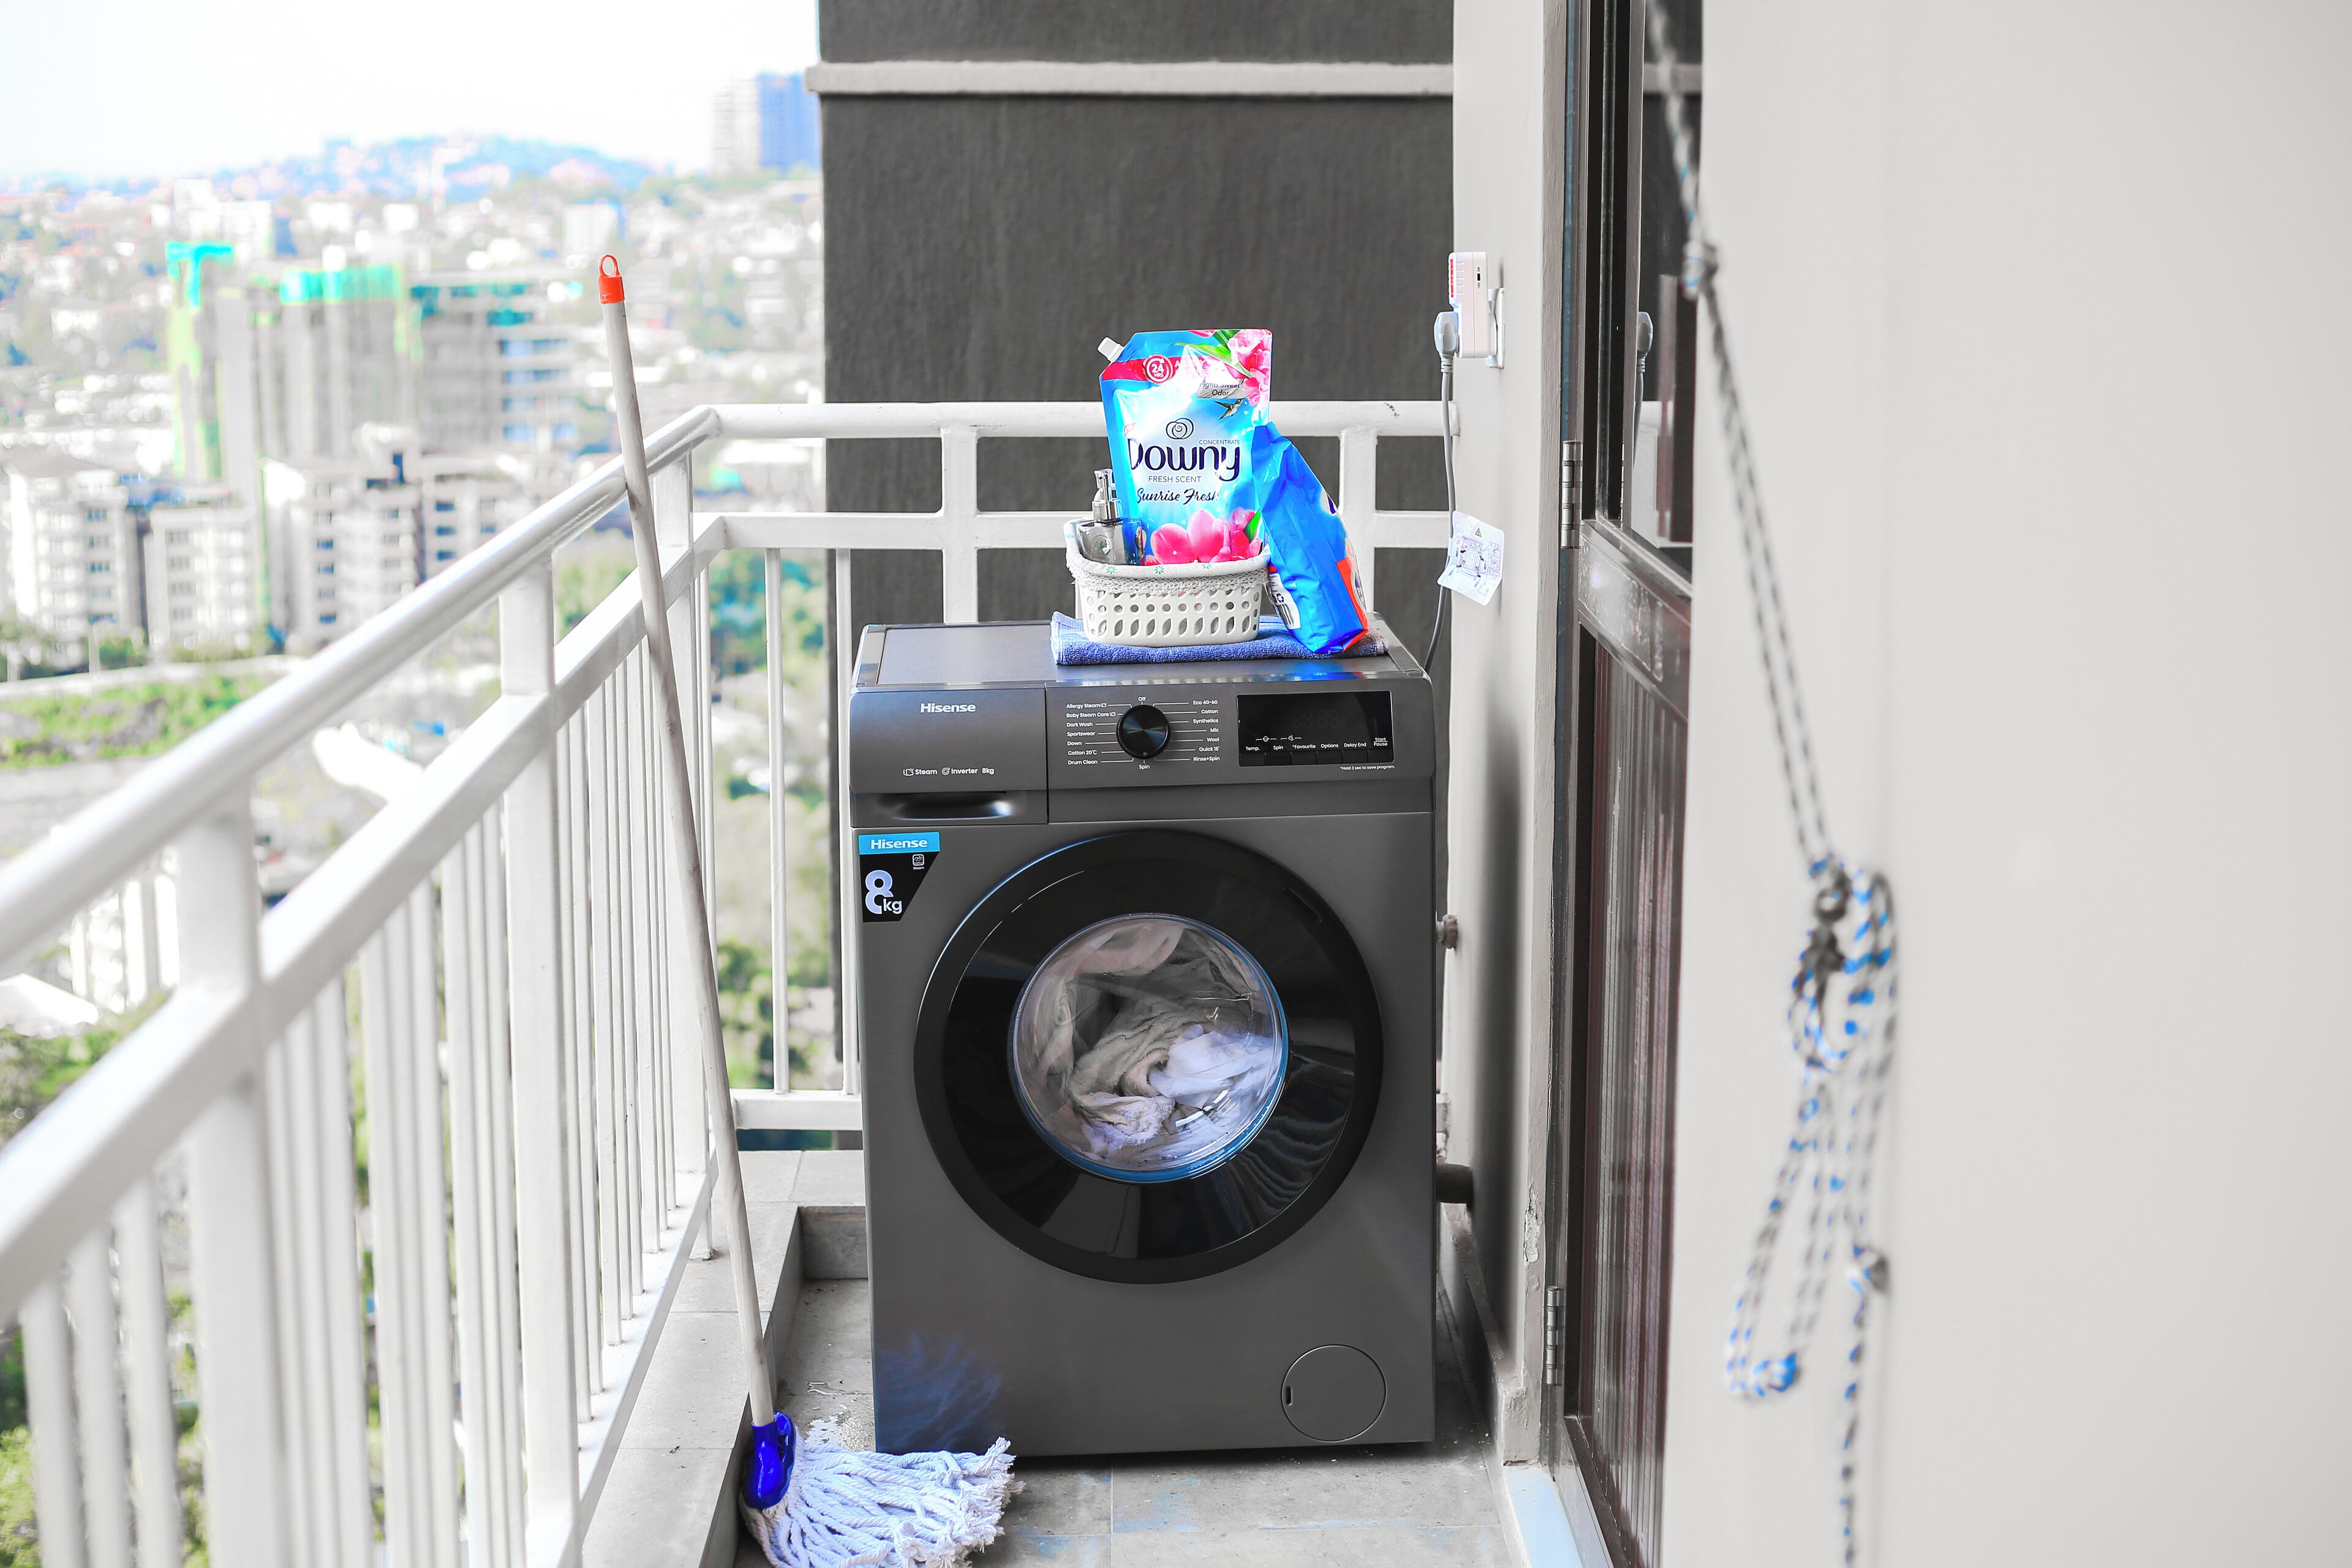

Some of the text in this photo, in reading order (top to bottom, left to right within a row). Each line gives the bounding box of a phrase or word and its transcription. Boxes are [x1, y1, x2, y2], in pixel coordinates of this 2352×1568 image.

[1152, 364, 1164, 372] 24
[1128, 438, 1240, 481] Downy
[1137, 488, 1181, 503] Sunrise
[920, 703, 976, 713] Hisense
[871, 839, 928, 850] Hisense
